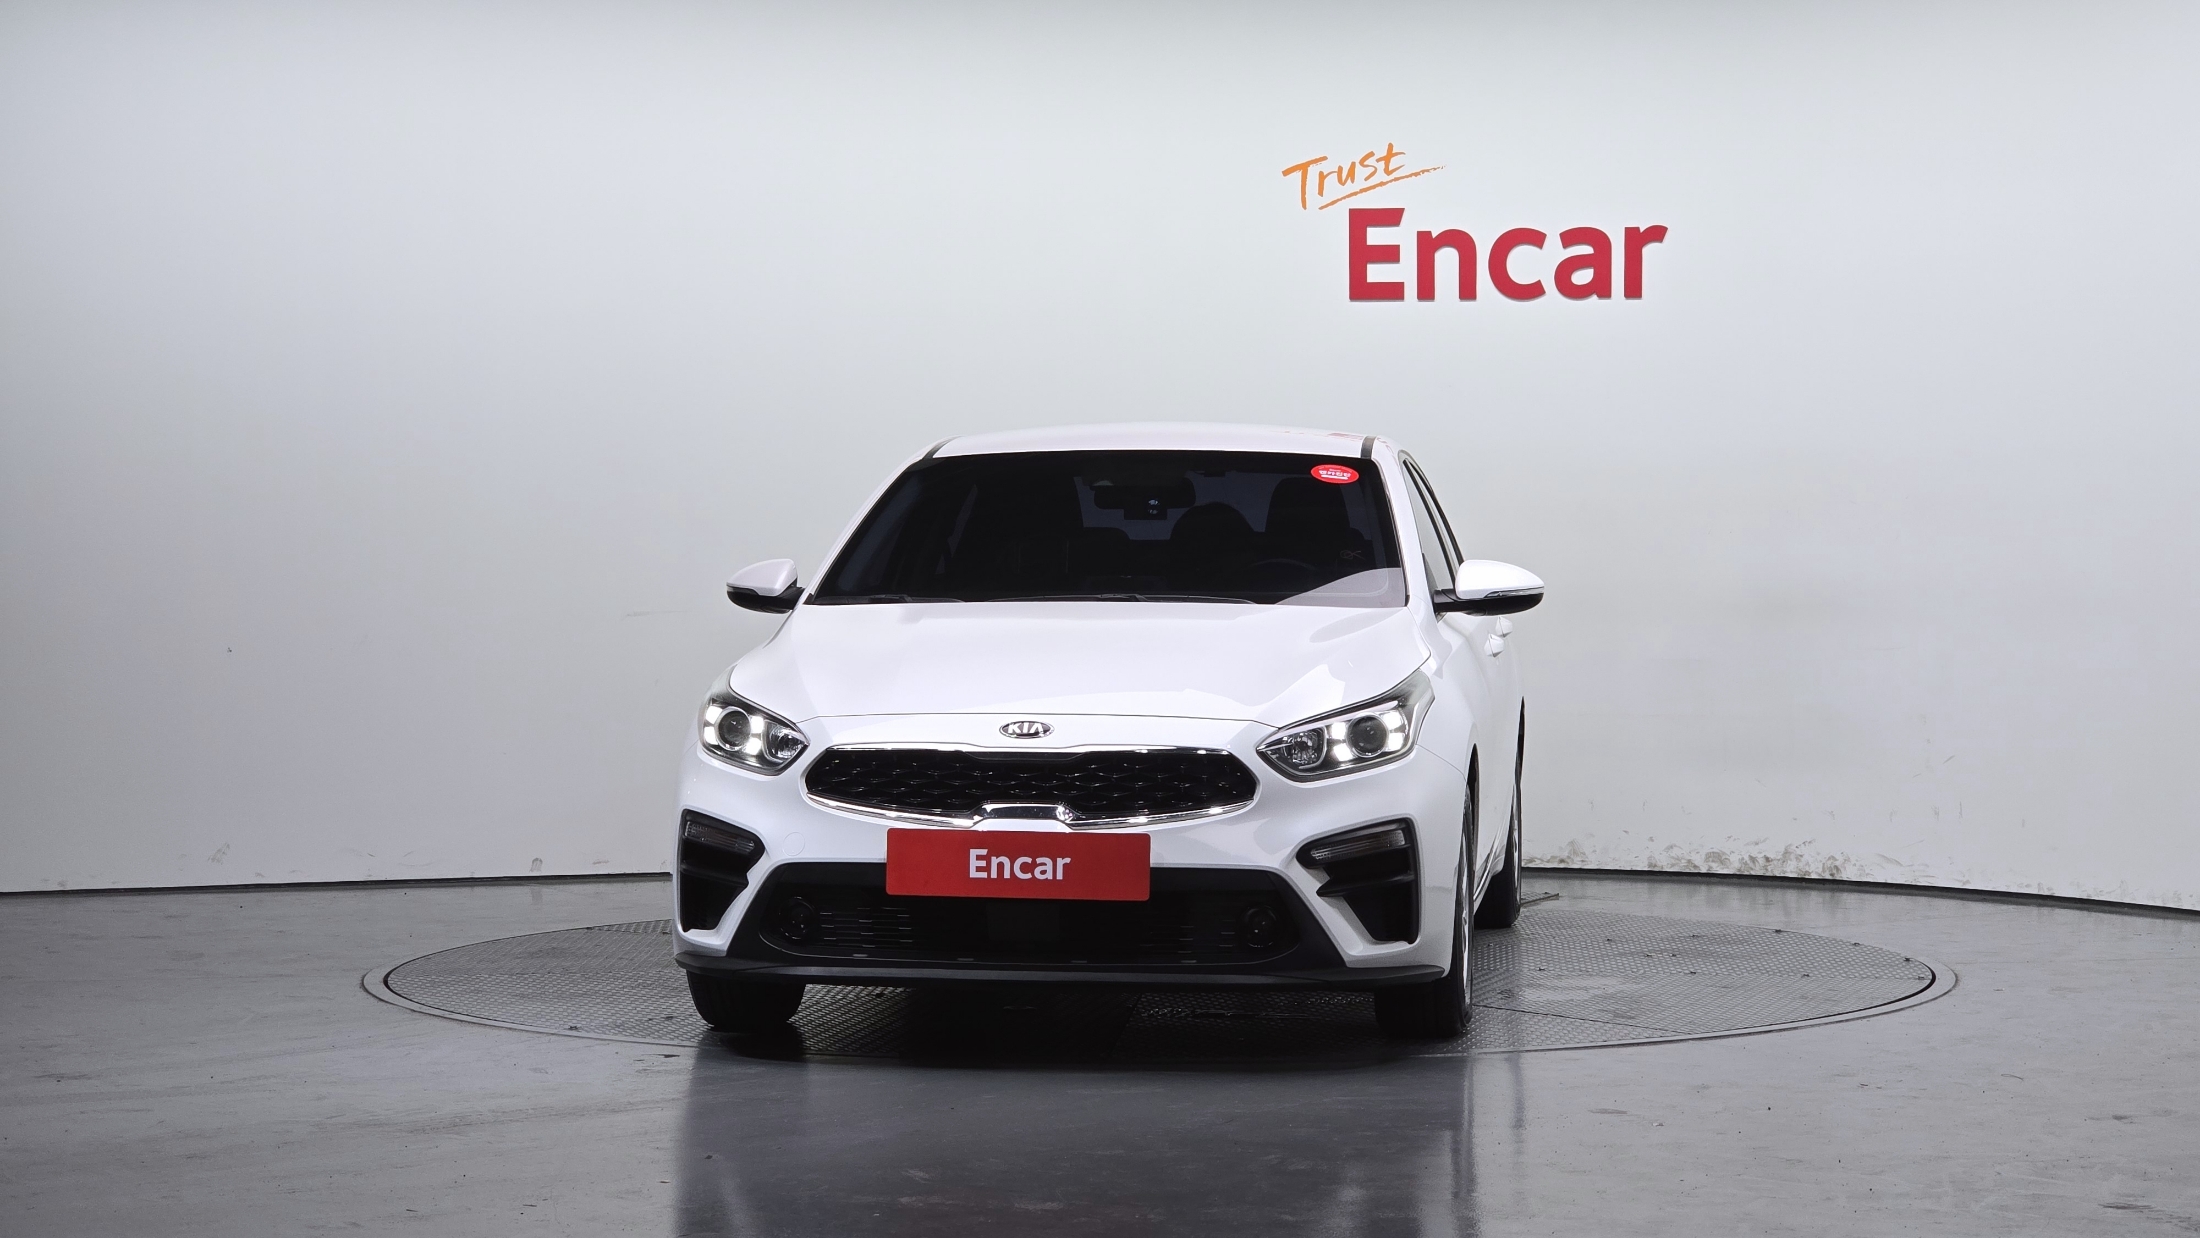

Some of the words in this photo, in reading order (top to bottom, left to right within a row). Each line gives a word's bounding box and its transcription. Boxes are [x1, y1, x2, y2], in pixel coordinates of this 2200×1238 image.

[1281, 142, 1407, 211] Trust
[1348, 207, 1668, 301] Encar
[1007, 721, 1044, 734] KIA
[969, 848, 1072, 880] Encar
